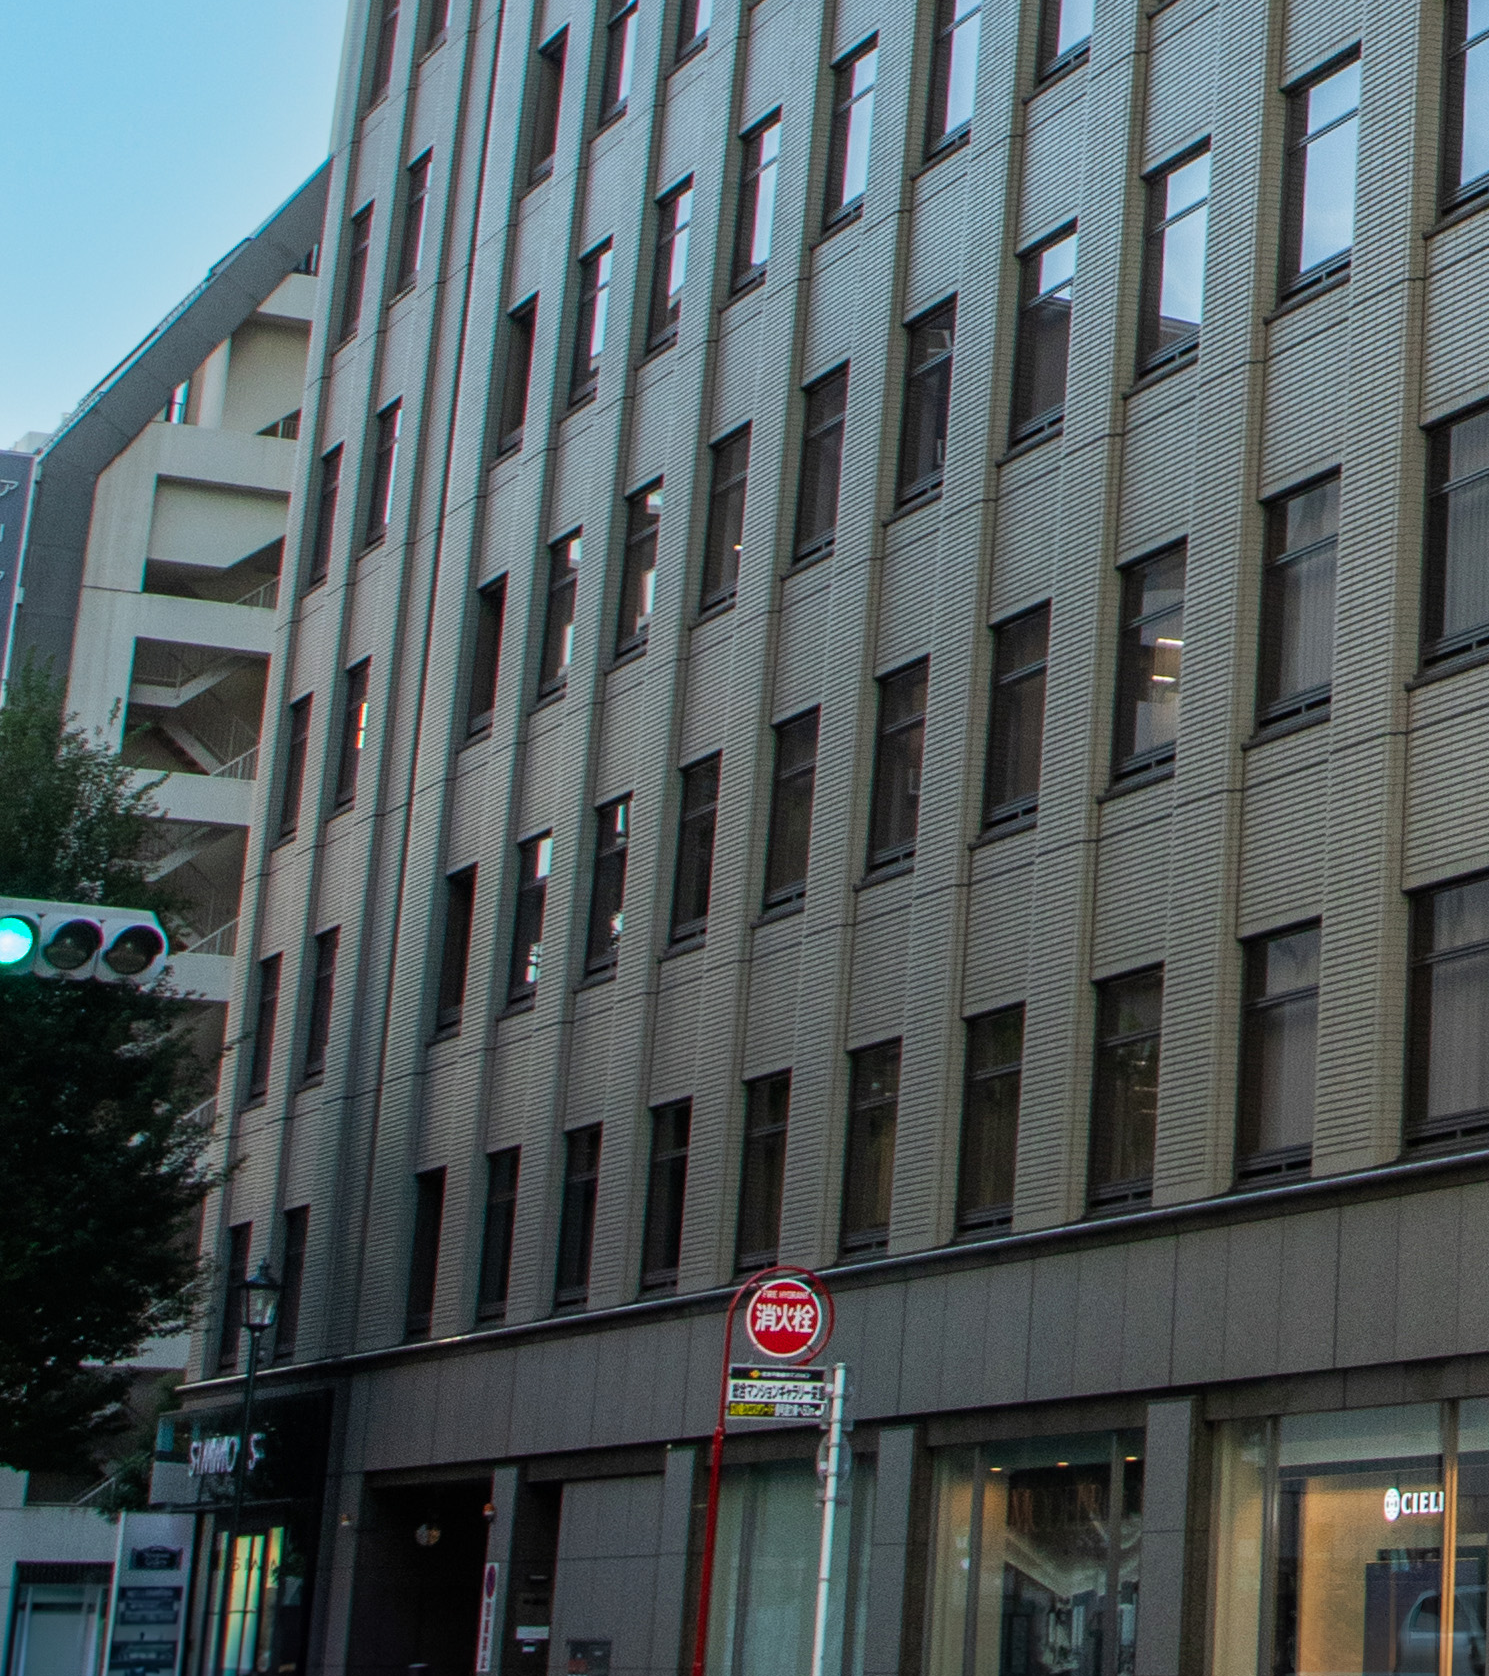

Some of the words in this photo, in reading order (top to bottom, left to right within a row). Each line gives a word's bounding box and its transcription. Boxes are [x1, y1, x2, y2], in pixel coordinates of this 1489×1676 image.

[755, 1303, 815, 1333] 消火栓
[188, 1433, 266, 1477] SIMMOS
[1401, 1491, 1445, 1514] CIELI
